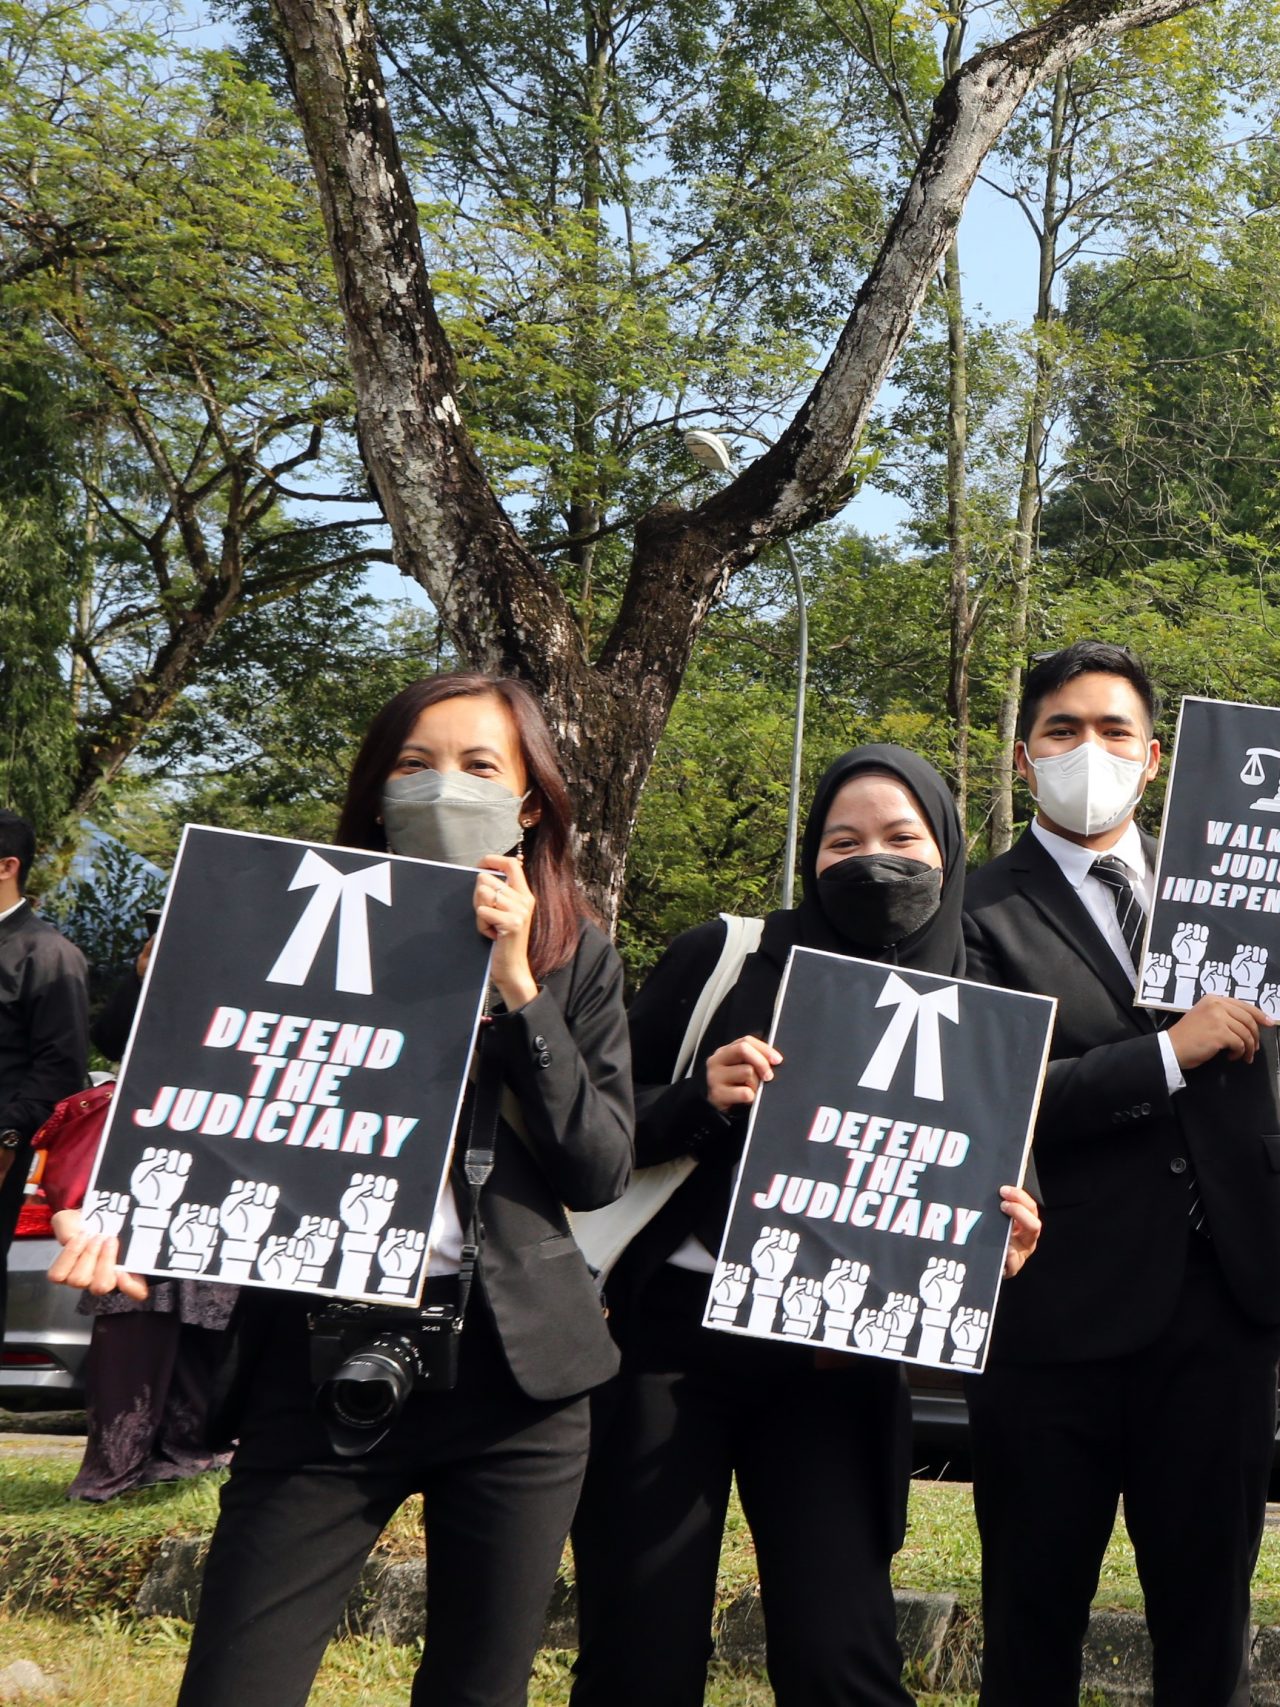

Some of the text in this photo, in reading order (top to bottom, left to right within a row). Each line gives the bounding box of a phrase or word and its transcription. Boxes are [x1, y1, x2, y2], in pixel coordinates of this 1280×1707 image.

[202, 1007, 404, 1071] DEFEND
[250, 1054, 352, 1106] THE
[133, 1086, 420, 1157] JUDICIARY
[807, 1106, 971, 1167] DEFEND
[846, 1150, 927, 1198] THE
[752, 1174, 984, 1245] JUDICIARY
